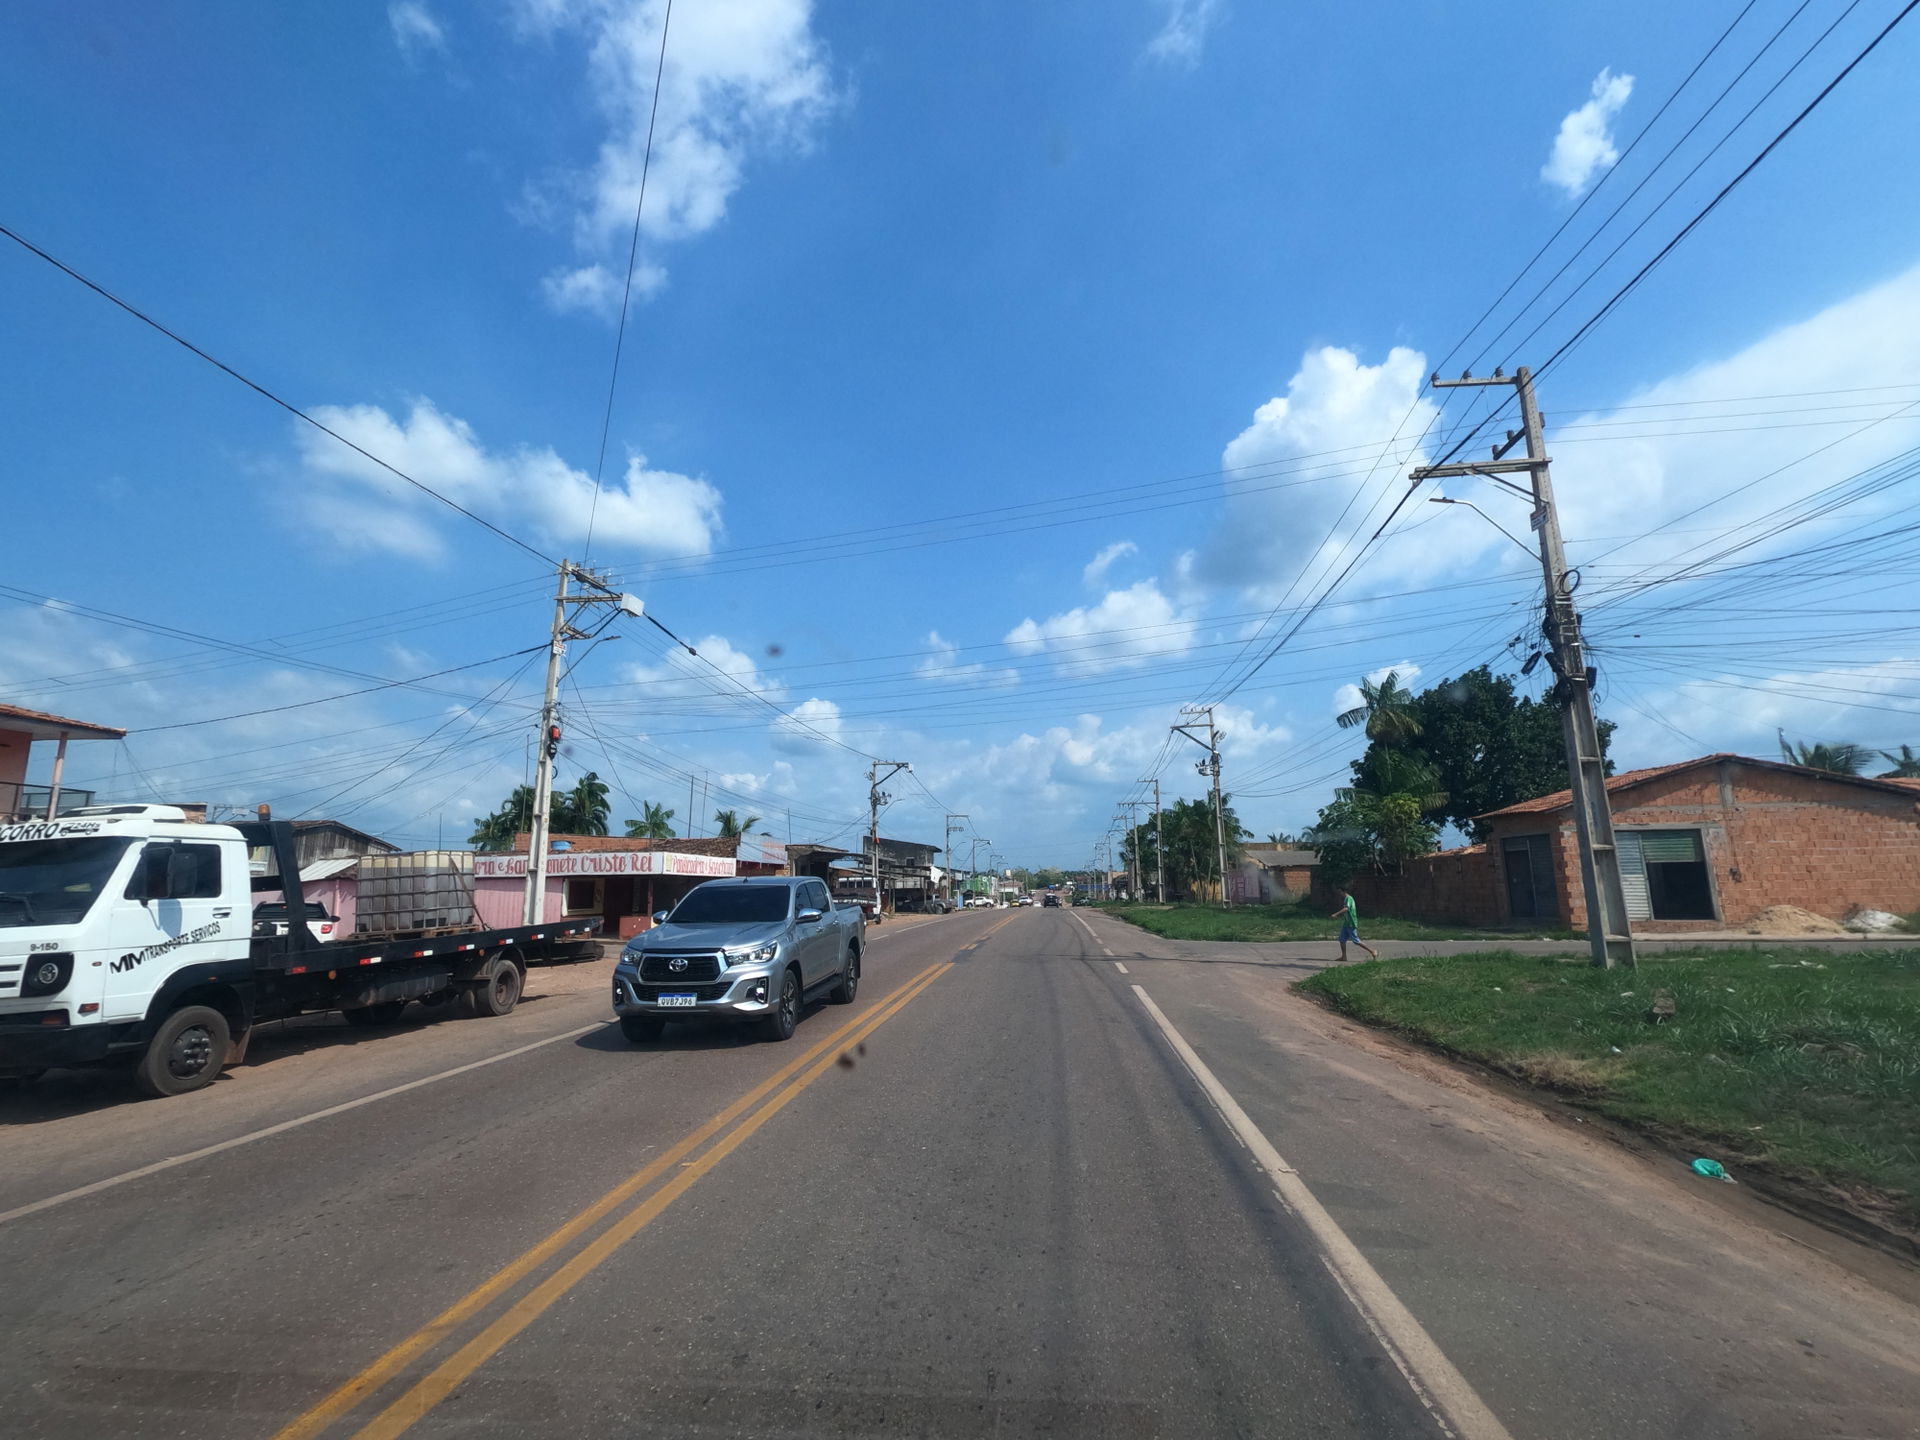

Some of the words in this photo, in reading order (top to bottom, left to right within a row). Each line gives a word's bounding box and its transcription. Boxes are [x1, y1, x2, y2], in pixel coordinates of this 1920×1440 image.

[0, 823, 60, 841] CORRO
[581, 854, 626, 873] Cristo
[630, 853, 652, 872] Rei
[30, 942, 59, 952] 9-150
